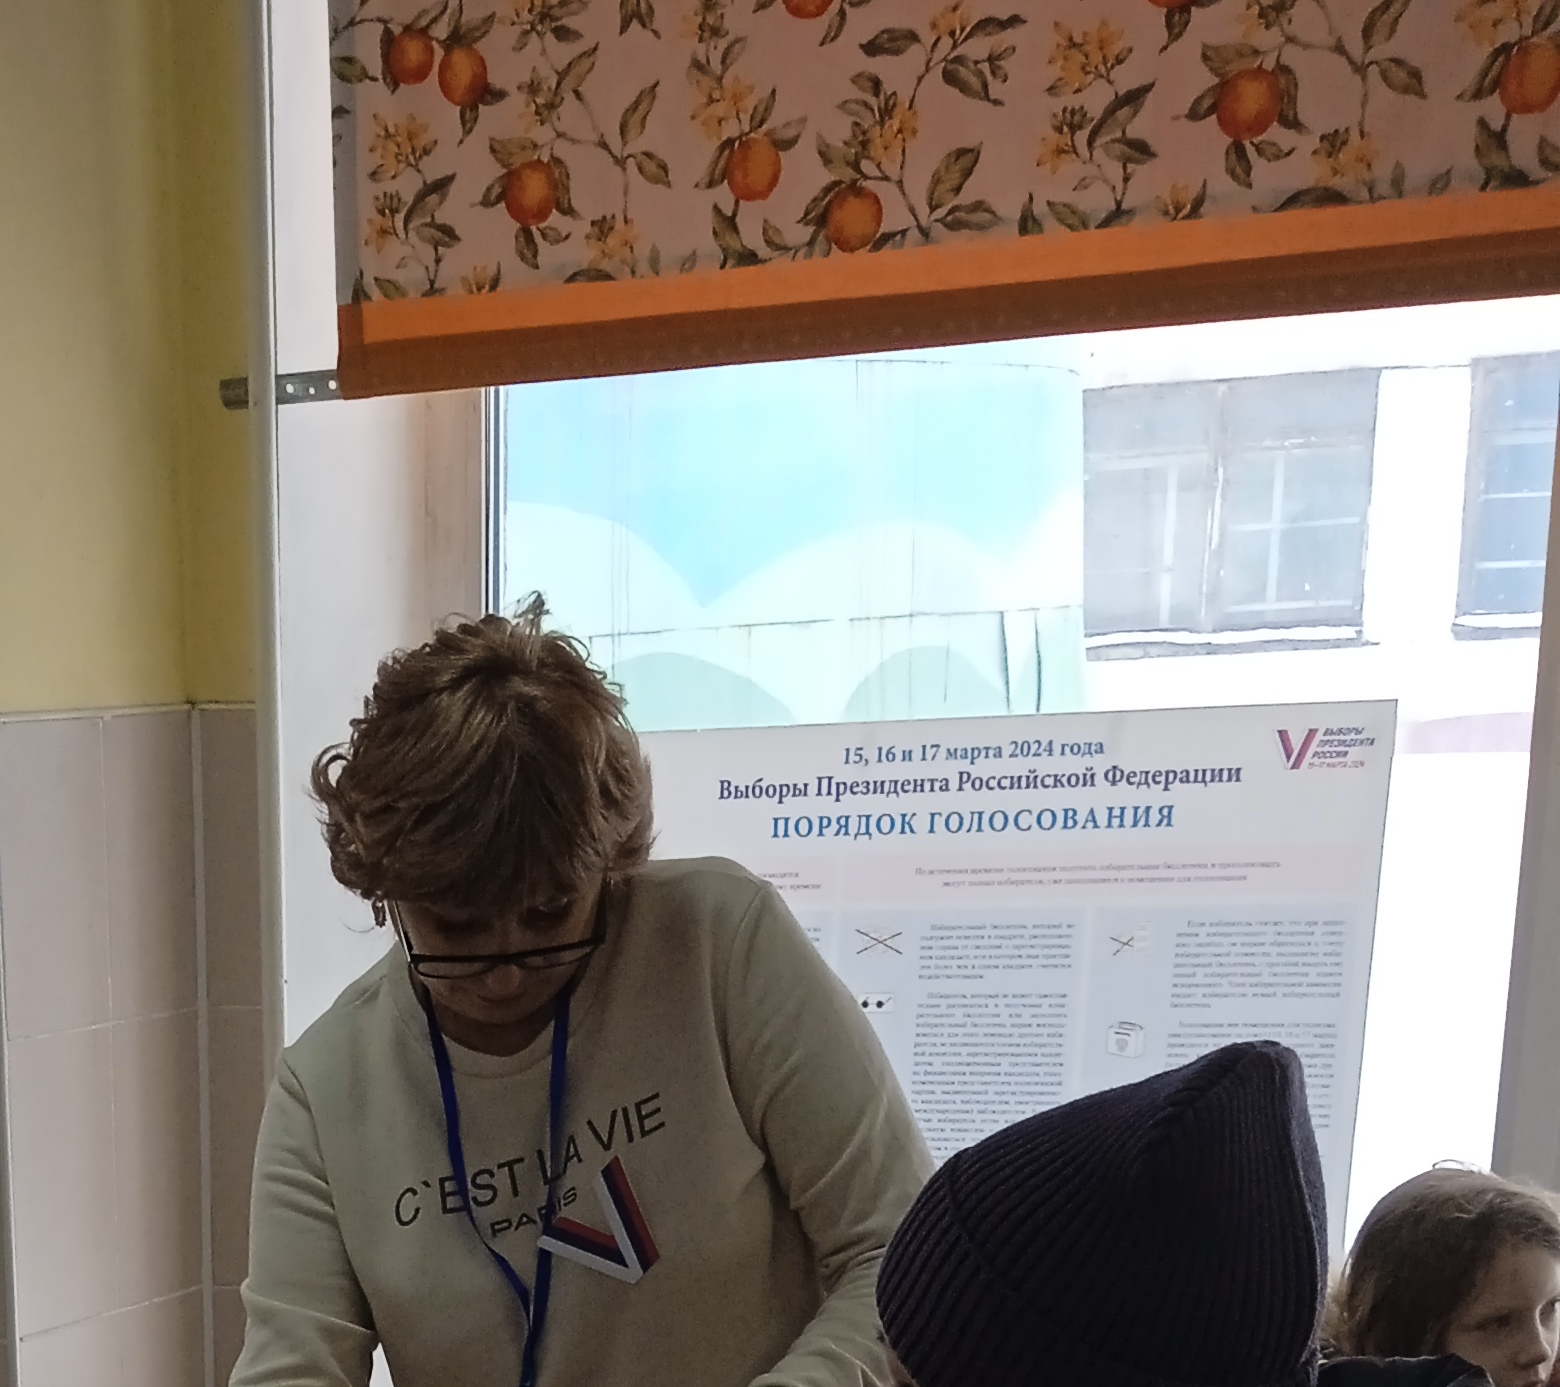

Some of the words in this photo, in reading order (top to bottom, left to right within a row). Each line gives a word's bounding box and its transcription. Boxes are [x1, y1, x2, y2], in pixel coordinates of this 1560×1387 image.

[843, 746, 870, 767] 15,
[876, 745, 896, 763] 16
[900, 748, 913, 762] и
[920, 744, 941, 762] 17
[945, 744, 1003, 766] марта
[1008, 740, 1054, 758] 2024
[1059, 740, 1105, 758] года
[718, 777, 809, 804] Выборы
[815, 775, 950, 802] Президента
[956, 766, 1097, 792] Российской
[1103, 765, 1243, 791] Федерации
[771, 813, 917, 841] ПОРЯДОК
[928, 805, 1175, 834] ГОЛОСОВАНИЯ
[535, 1134, 583, 1187] LA
[585, 1091, 667, 1152] VIE
